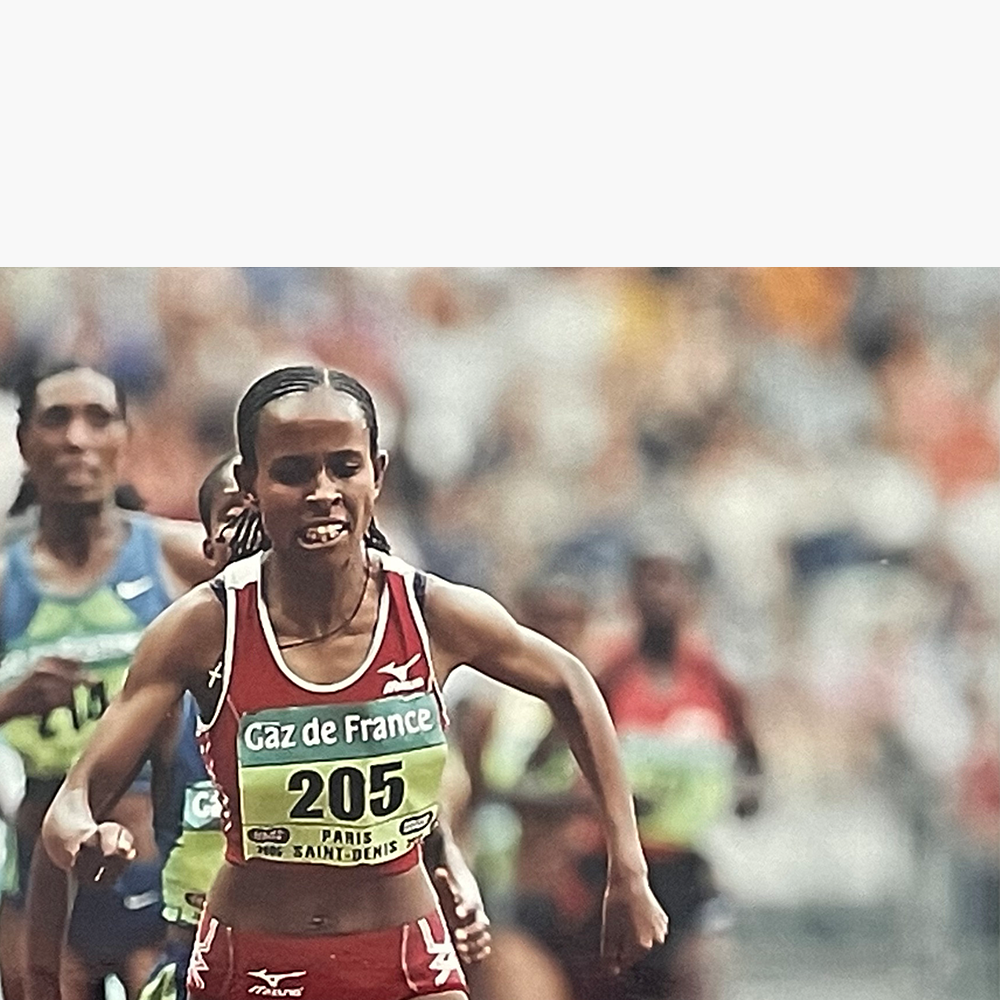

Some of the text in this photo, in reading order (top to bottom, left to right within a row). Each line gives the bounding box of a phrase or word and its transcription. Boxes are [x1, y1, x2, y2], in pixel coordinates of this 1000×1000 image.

[243, 707, 434, 751] Gaz de France
[287, 760, 406, 822] 205
[292, 840, 398, 862] SAINT-DENIS
[321, 829, 373, 846] PARIS
